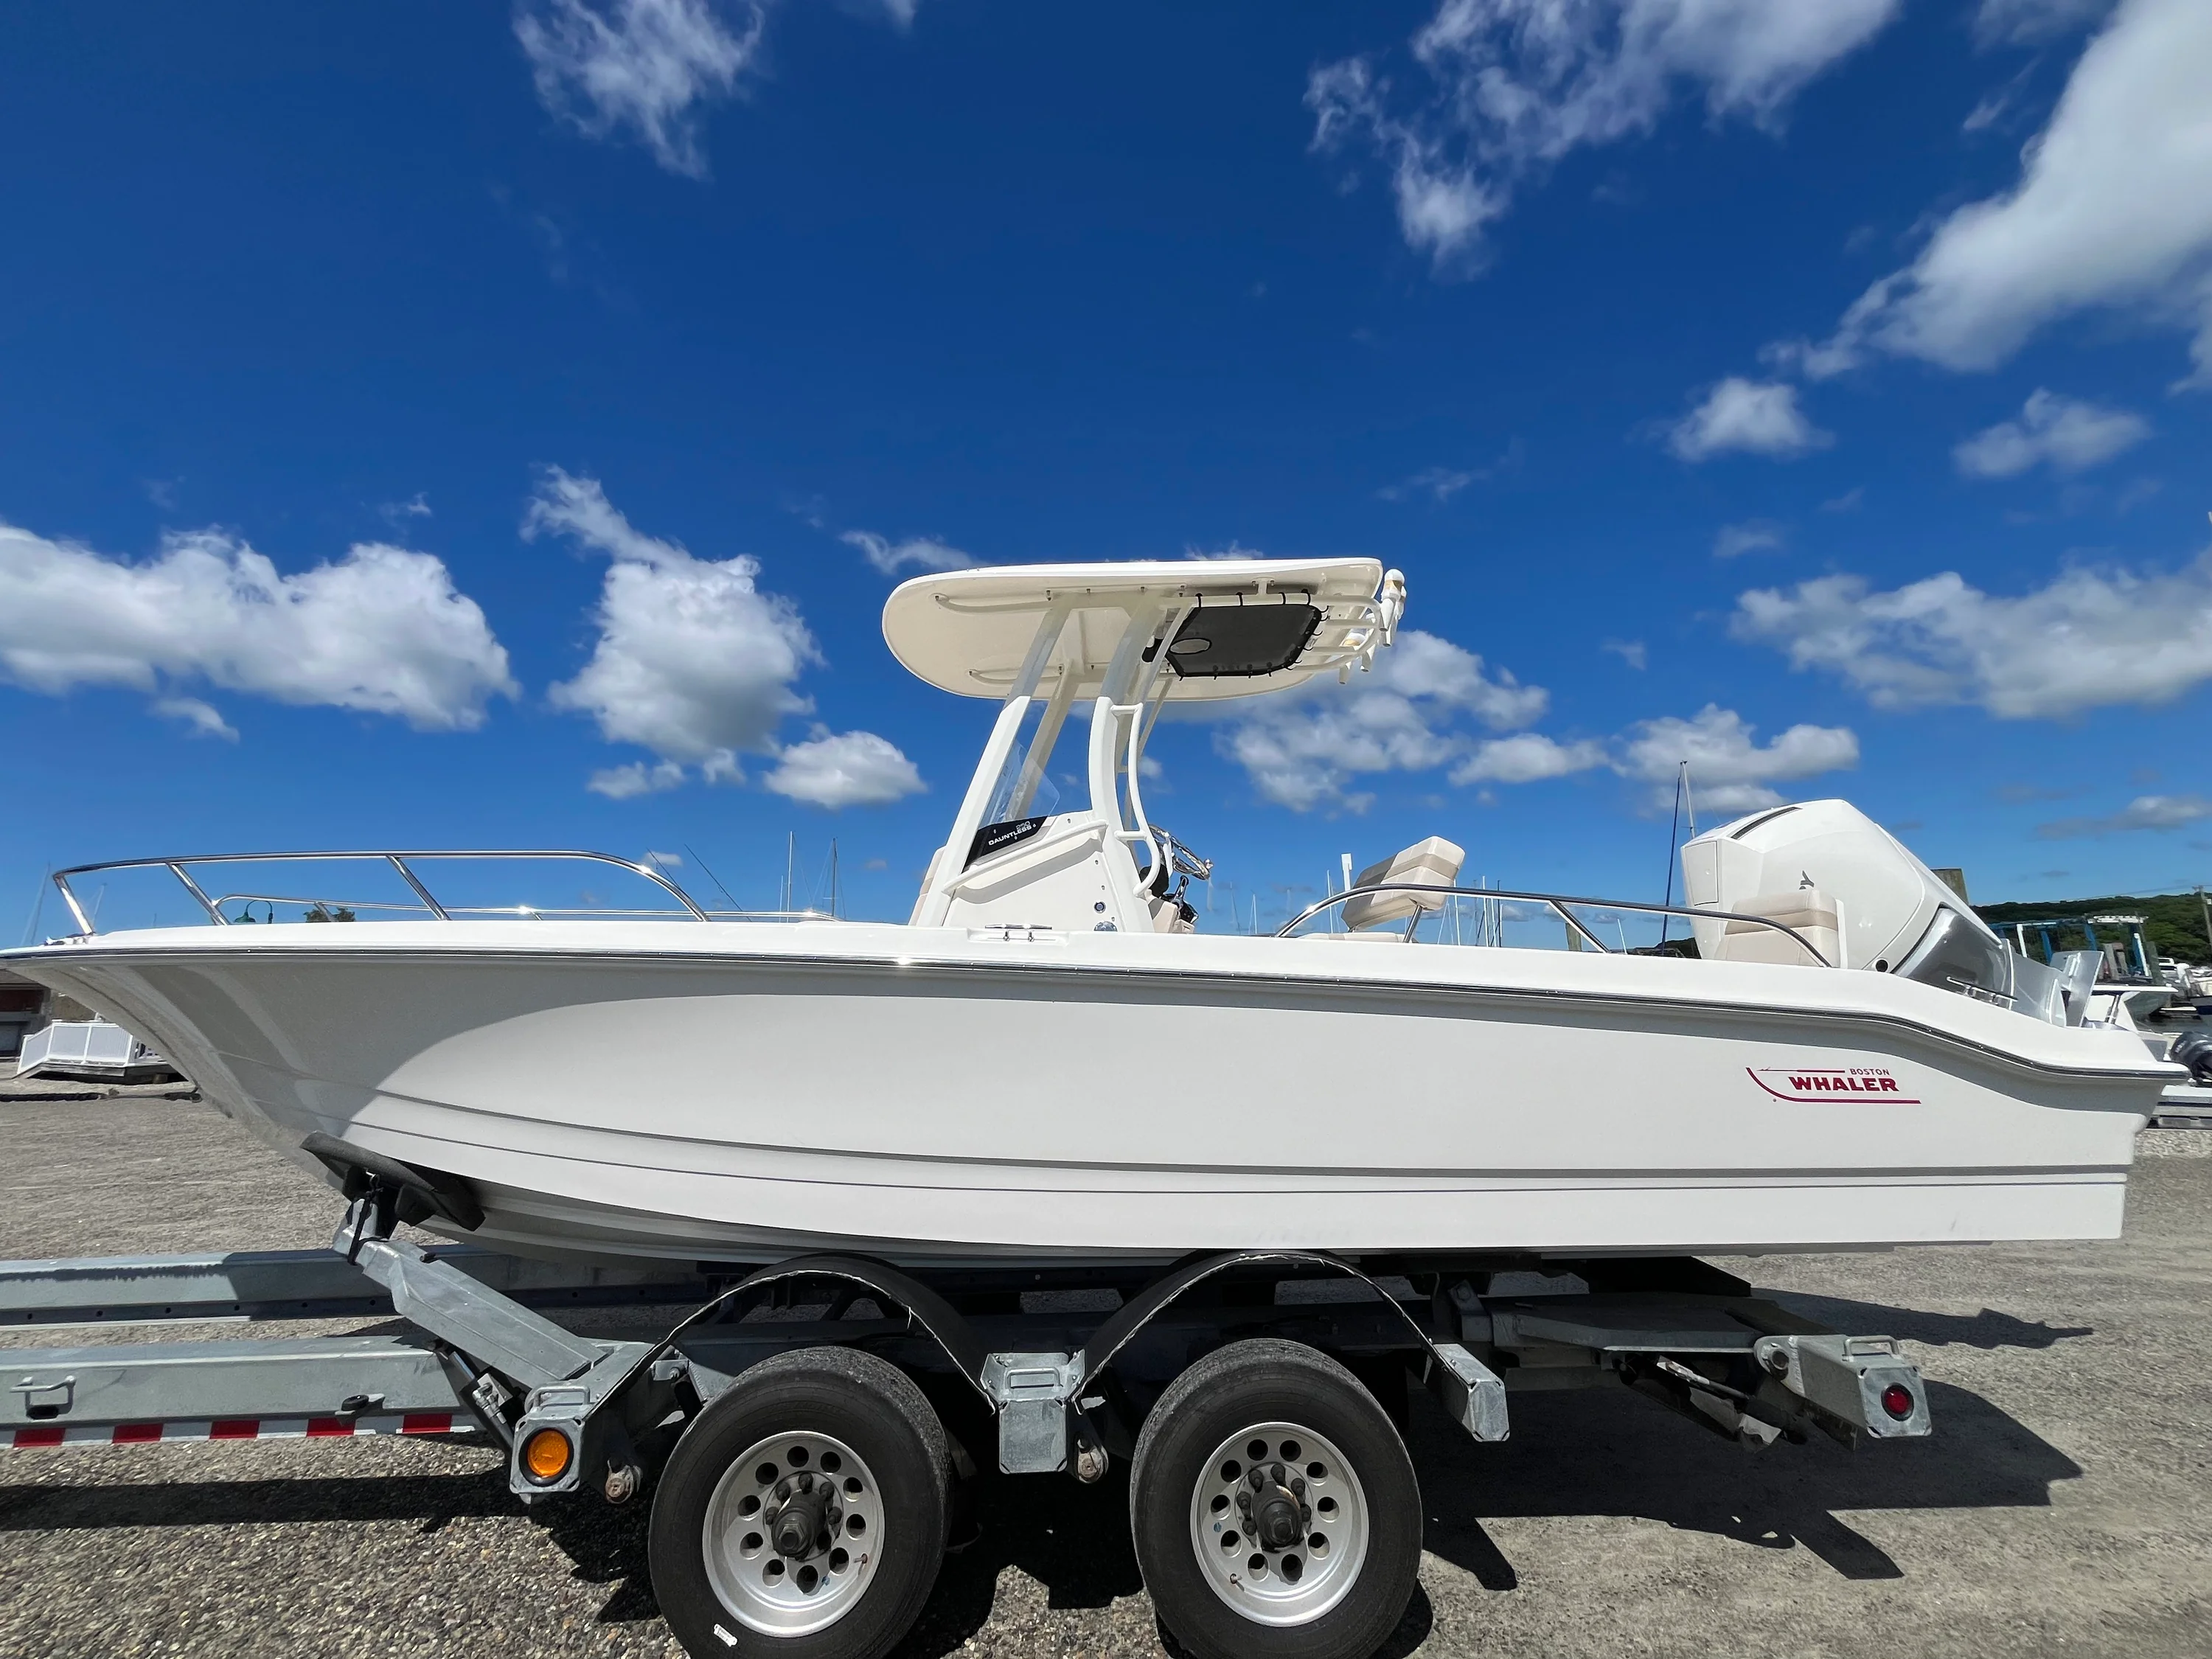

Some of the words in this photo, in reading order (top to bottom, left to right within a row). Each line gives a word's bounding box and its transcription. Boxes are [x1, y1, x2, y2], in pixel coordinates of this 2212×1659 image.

[1015, 821, 1031, 830] 250
[988, 825, 1032, 846] DAUNTLESS
[1788, 1077, 1899, 1091] WHALER
